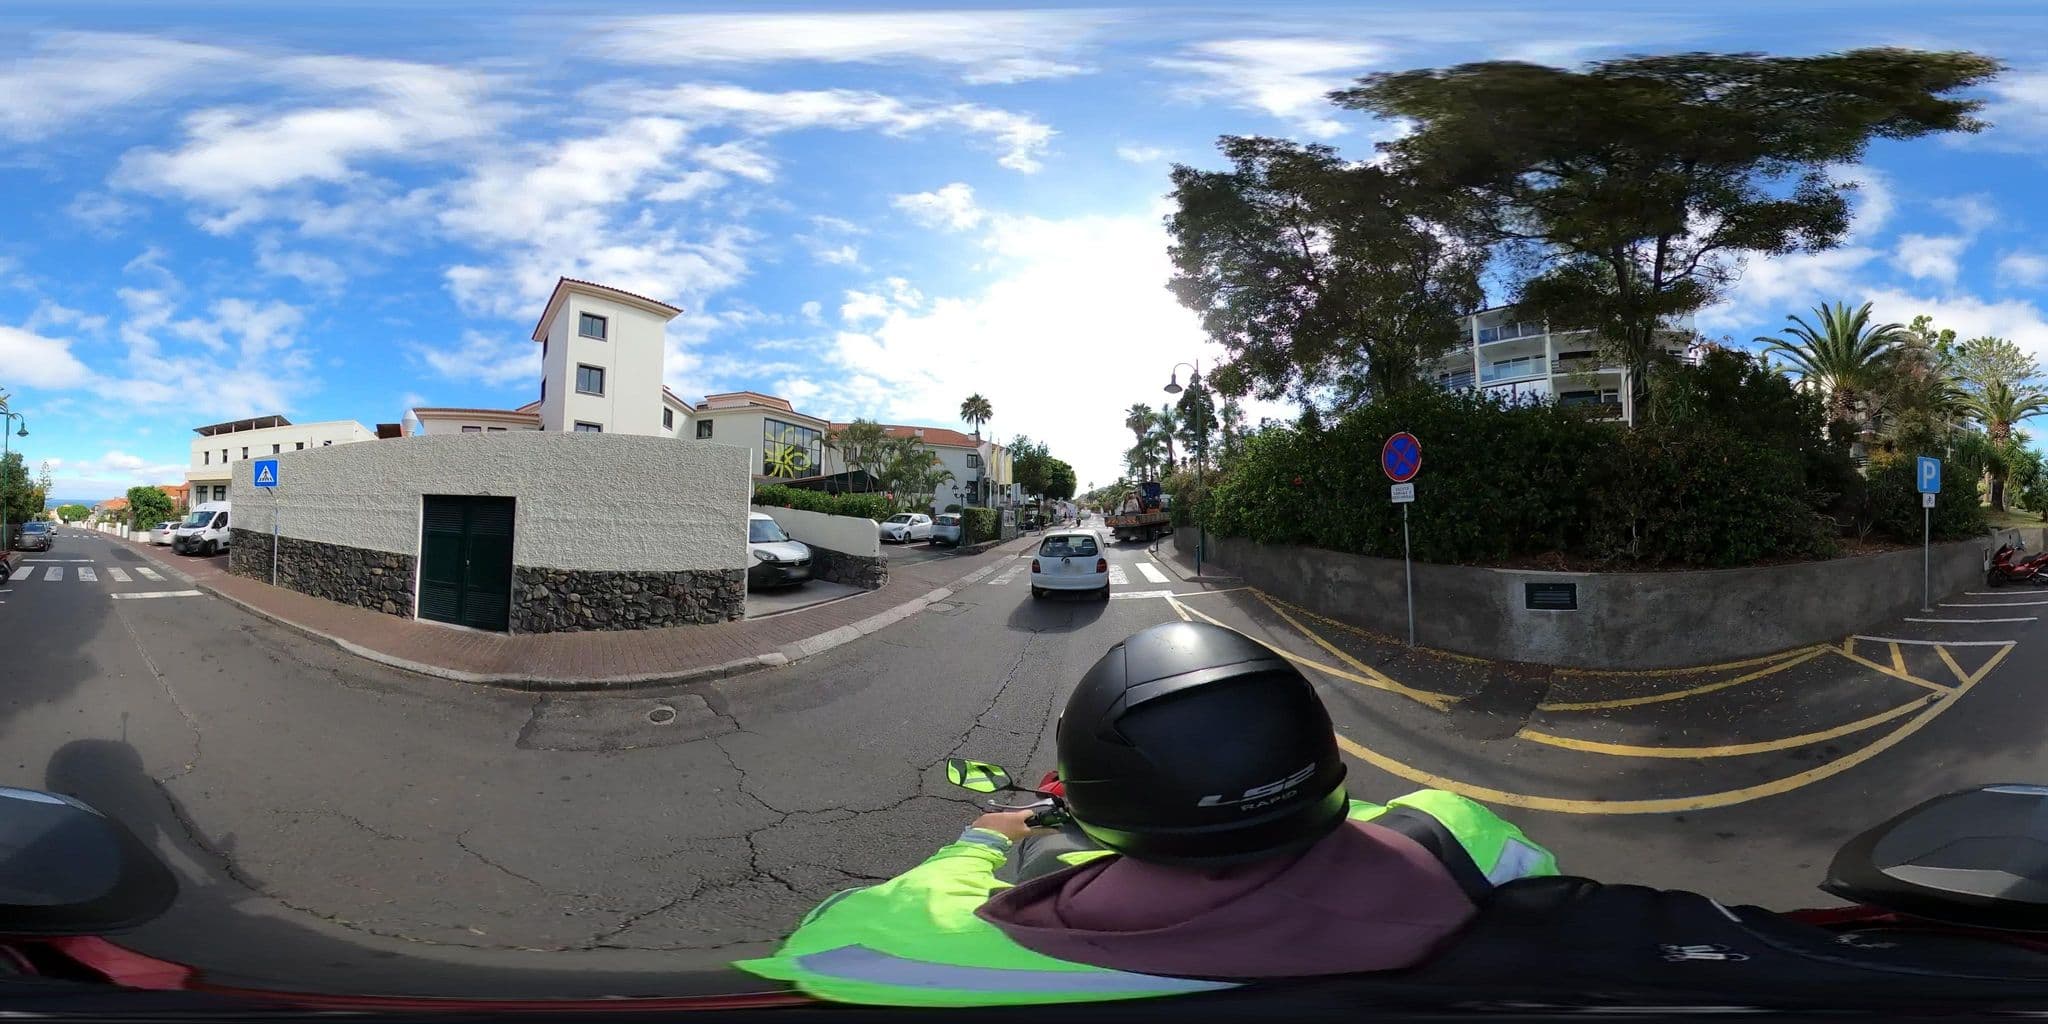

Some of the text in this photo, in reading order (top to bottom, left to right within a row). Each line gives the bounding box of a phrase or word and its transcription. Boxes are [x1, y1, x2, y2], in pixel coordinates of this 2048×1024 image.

[1923, 461, 1936, 489] P
[1198, 762, 1316, 807] LS2
[1241, 790, 1297, 811] RAPID
